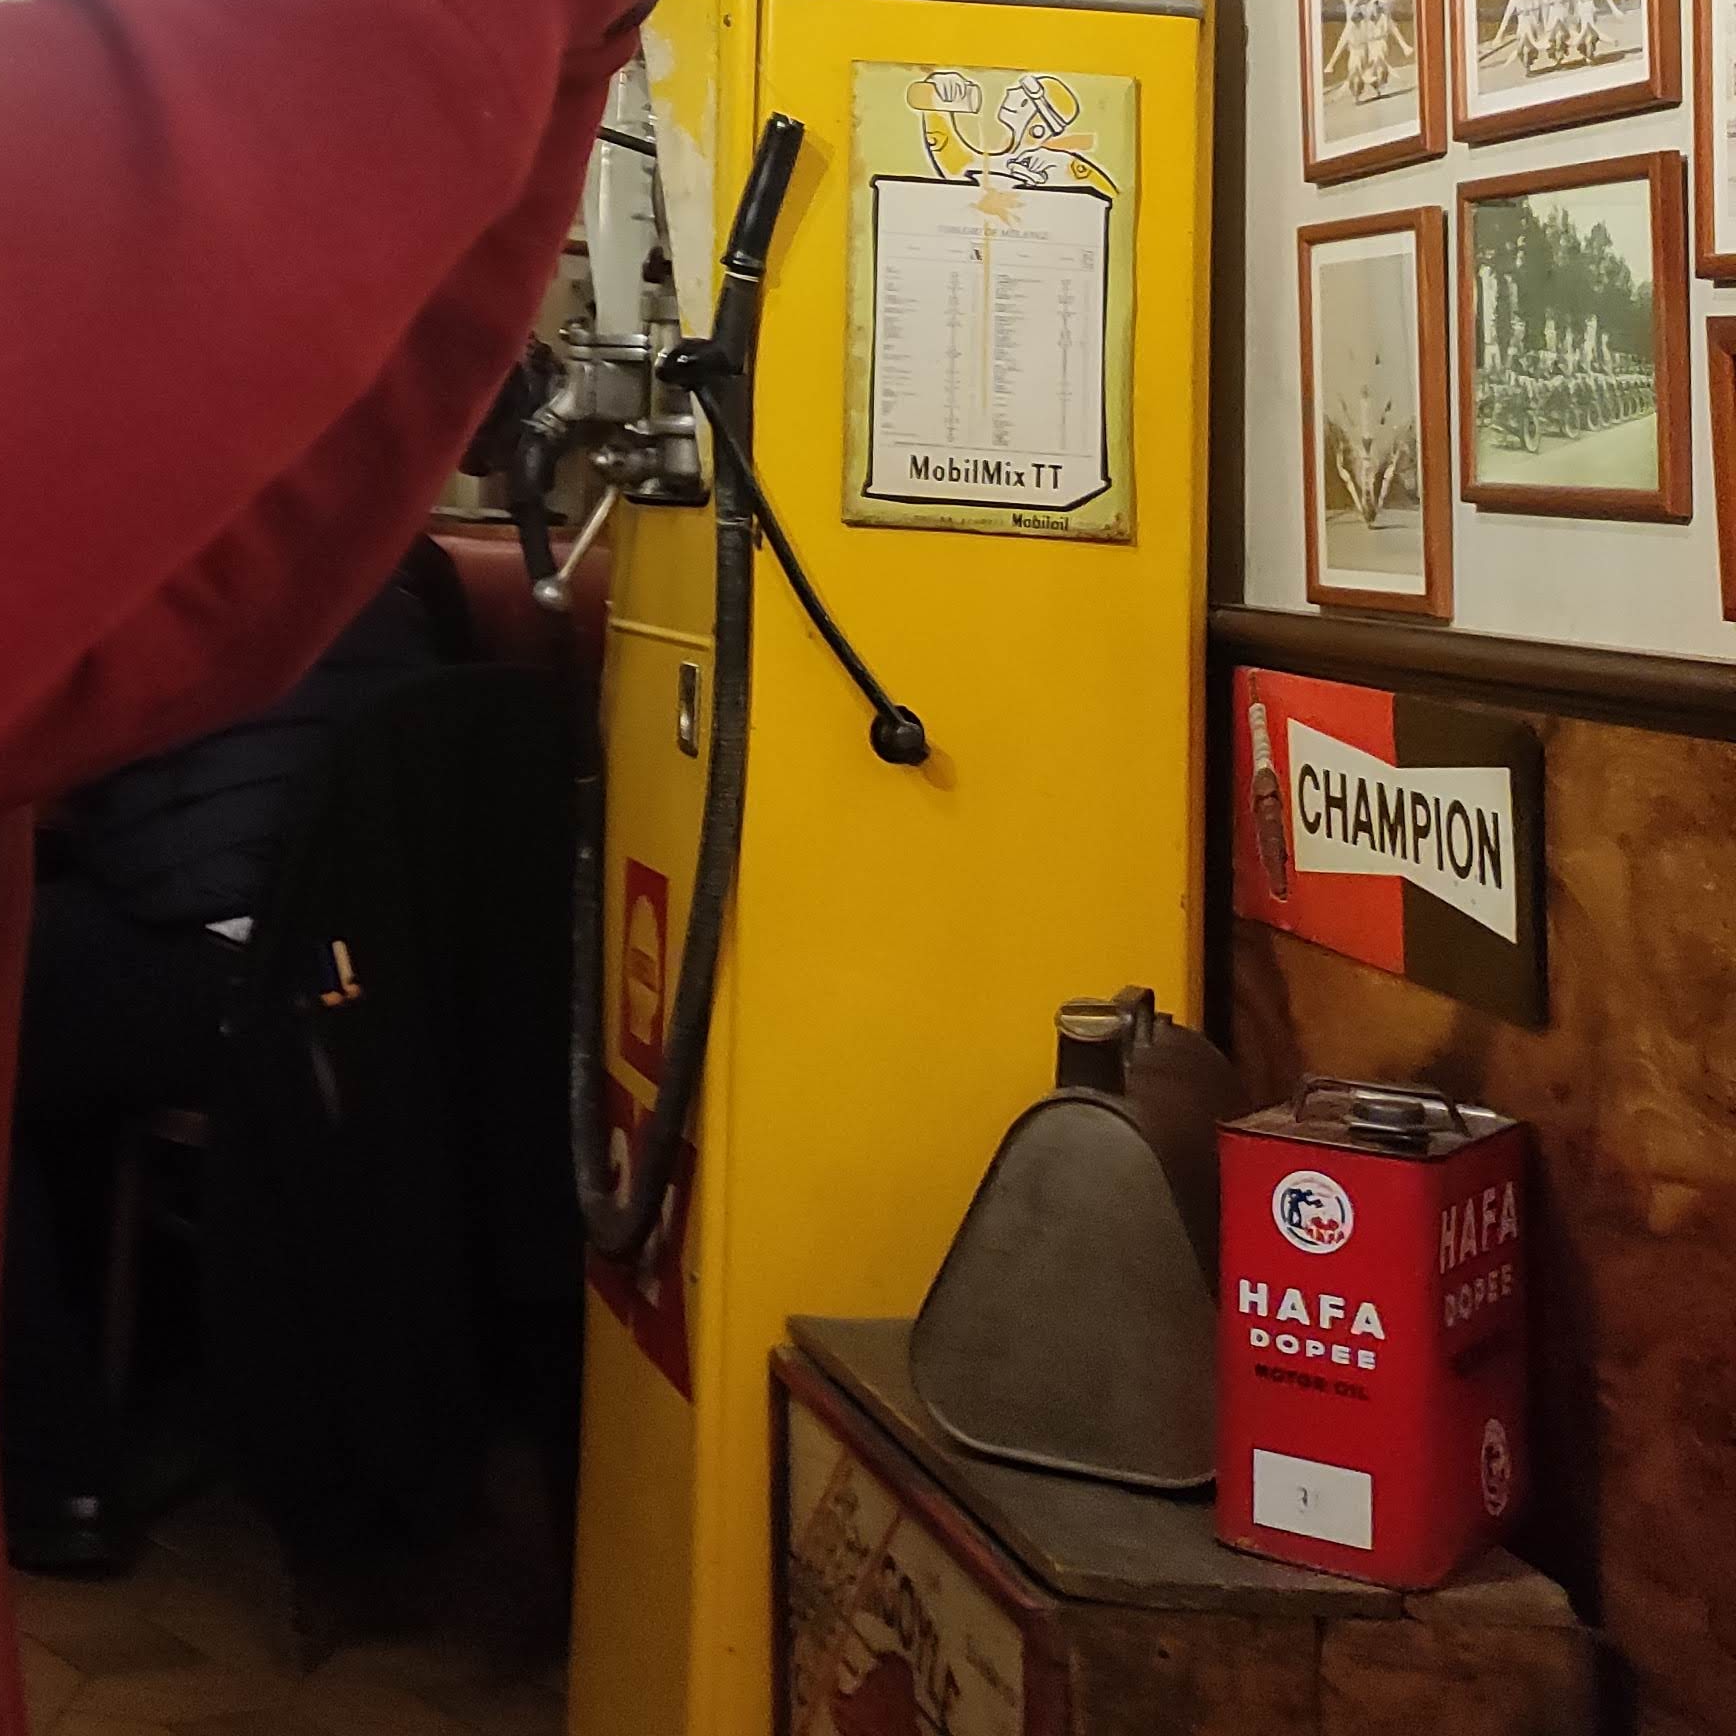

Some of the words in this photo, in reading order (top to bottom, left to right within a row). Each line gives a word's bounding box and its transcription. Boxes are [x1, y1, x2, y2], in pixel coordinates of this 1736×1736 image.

[909, 454, 1025, 488] MobilMix
[1032, 463, 1063, 489] TT
[1298, 763, 1503, 890] CHAMPION
[1440, 1180, 1519, 1275] HAFA
[1238, 1279, 1386, 1341] HAFA
[1250, 1328, 1377, 1371] DOPEE
